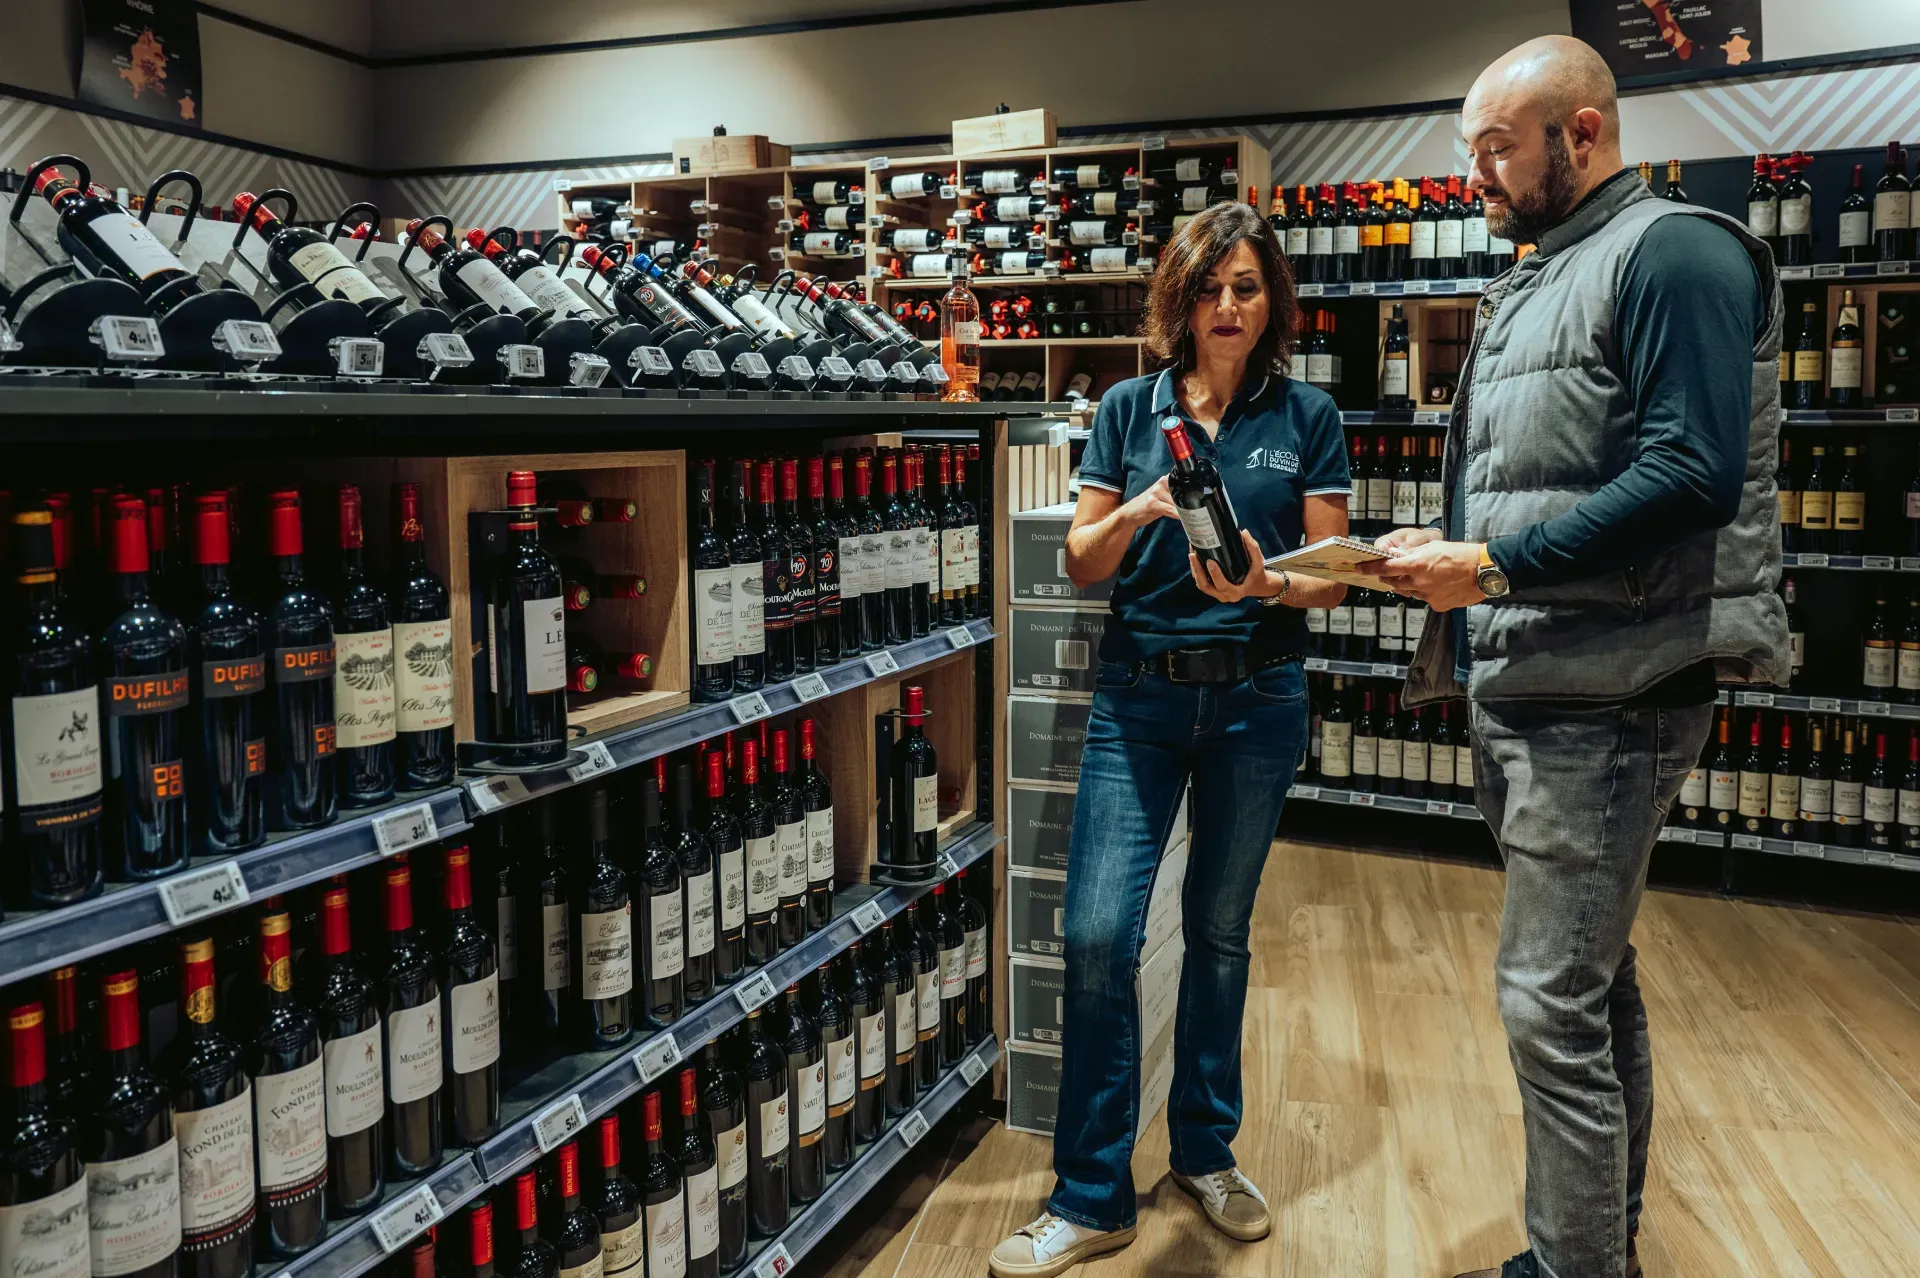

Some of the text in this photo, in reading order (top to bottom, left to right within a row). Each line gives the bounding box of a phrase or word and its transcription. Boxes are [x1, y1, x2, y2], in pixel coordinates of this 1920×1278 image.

[1683, 5, 1707, 13] PAUILLAC
[1679, 10, 1712, 20] SAINT-JULIEN
[1645, 51, 1670, 59] MARGAUX
[1269, 450, 1299, 461] L'ÉCOLE
[1269, 464, 1298, 474] BORDEAUX
[1291, 460, 1300, 468] DE
[1030, 623, 1064, 633] DOMAINE
[1029, 732, 1062, 742] DOMAINE
[1029, 819, 1062, 830] DOMAINE
[1029, 891, 1063, 901] DOMAINE
[1031, 979, 1065, 990] DOMAINE
[461, 1021, 488, 1036] MOULIN
[399, 1047, 428, 1065] MOULIN
[335, 1077, 366, 1096] MOULIN
[1026, 1082, 1060, 1093] DOMAINE
[271, 1094, 306, 1120] FOND
[183, 1133, 221, 1160] FOND
[269, 1188, 316, 1208] VIEILLES
[183, 1229, 235, 1252] VIEILLES
[664, 1254, 675, 1265] DE
